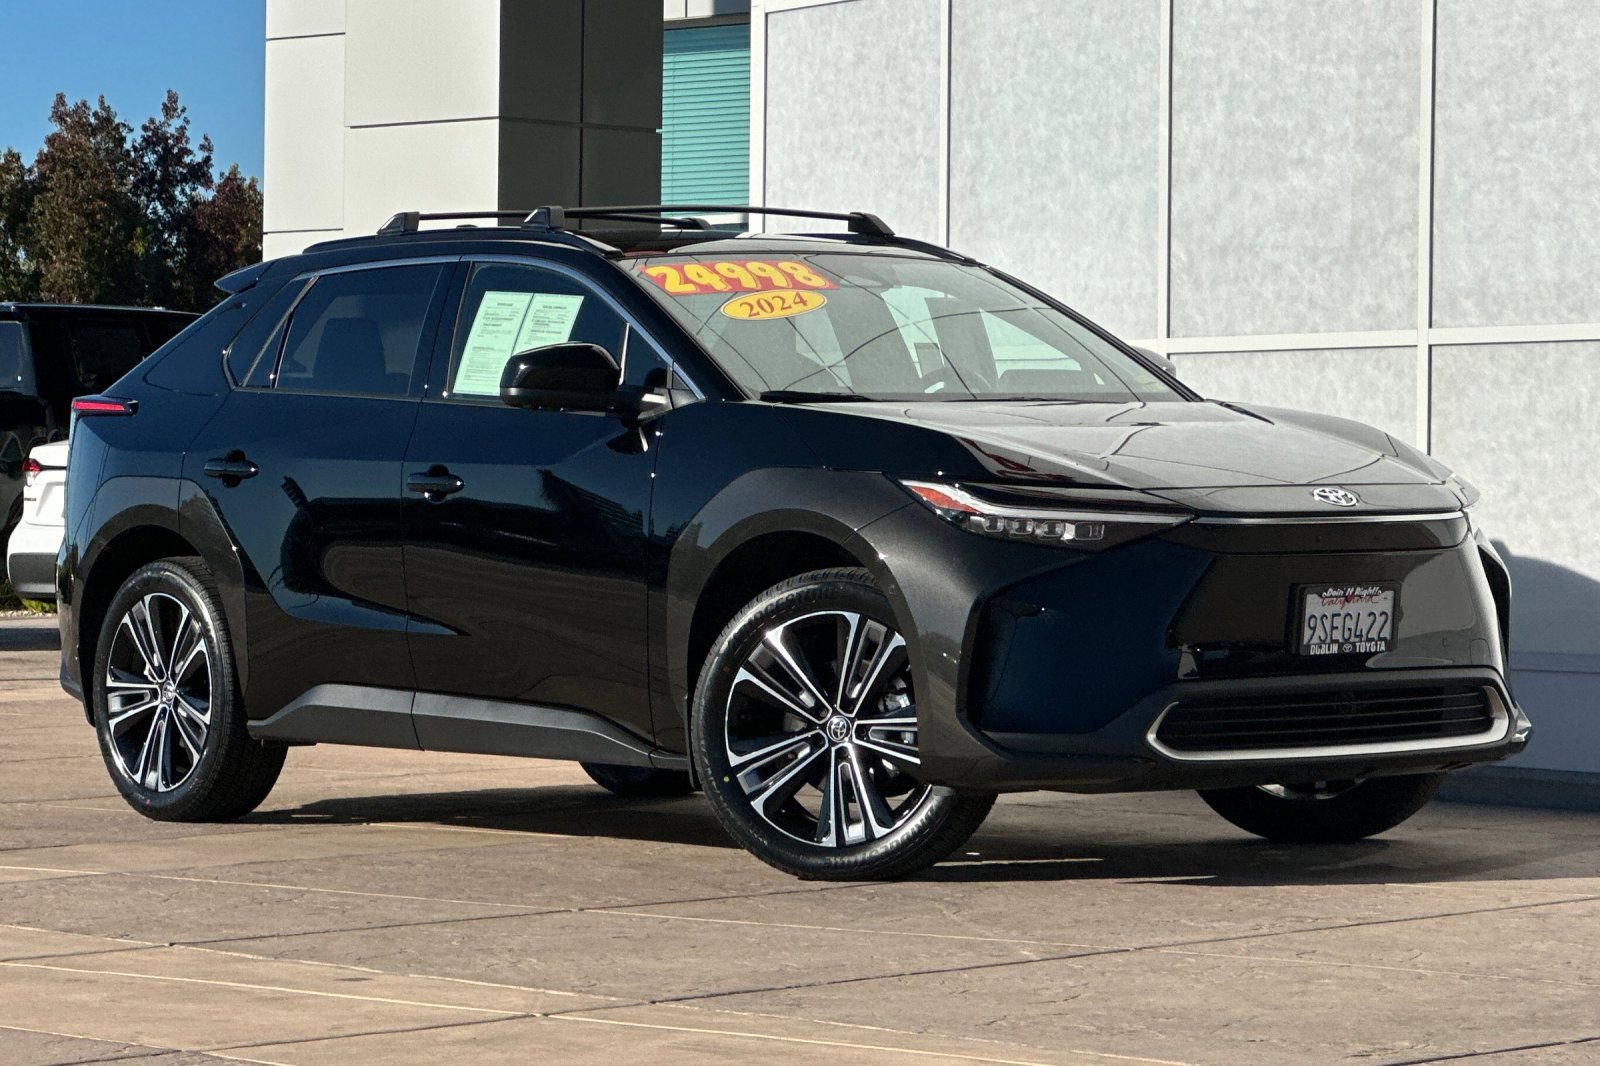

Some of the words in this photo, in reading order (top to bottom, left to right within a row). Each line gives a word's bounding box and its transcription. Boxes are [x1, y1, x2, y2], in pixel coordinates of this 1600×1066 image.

[645, 261, 829, 293] 24998
[739, 291, 808, 318] 2024
[1307, 612, 1389, 644] 9SEG422
[1310, 644, 1338, 655] DUBLIN
[1356, 641, 1385, 653] TOYOTA
